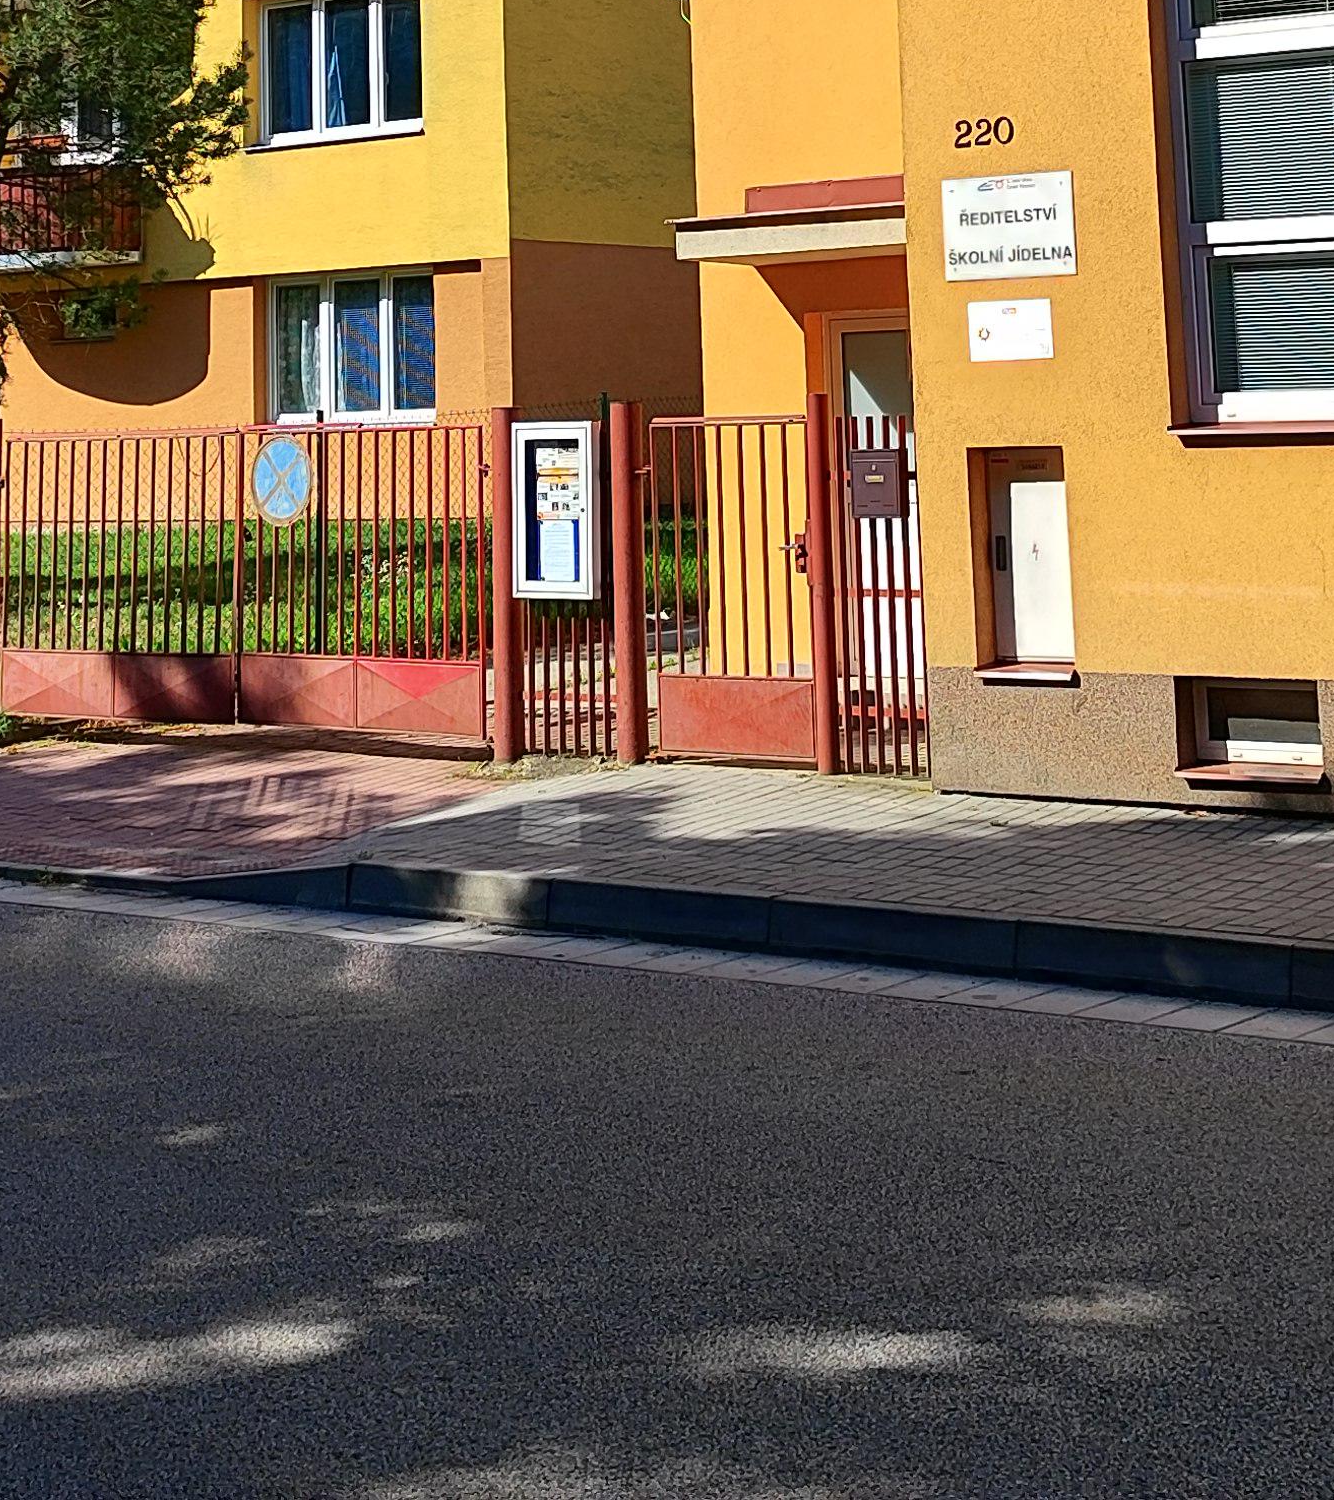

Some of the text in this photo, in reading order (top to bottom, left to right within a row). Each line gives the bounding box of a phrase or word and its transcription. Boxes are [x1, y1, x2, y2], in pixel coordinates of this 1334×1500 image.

[954, 116, 1014, 148] 220
[959, 203, 1057, 226] ŘEDITELSTVÍ
[948, 244, 1072, 265] ŠKOLNÍ JÍDELNA
